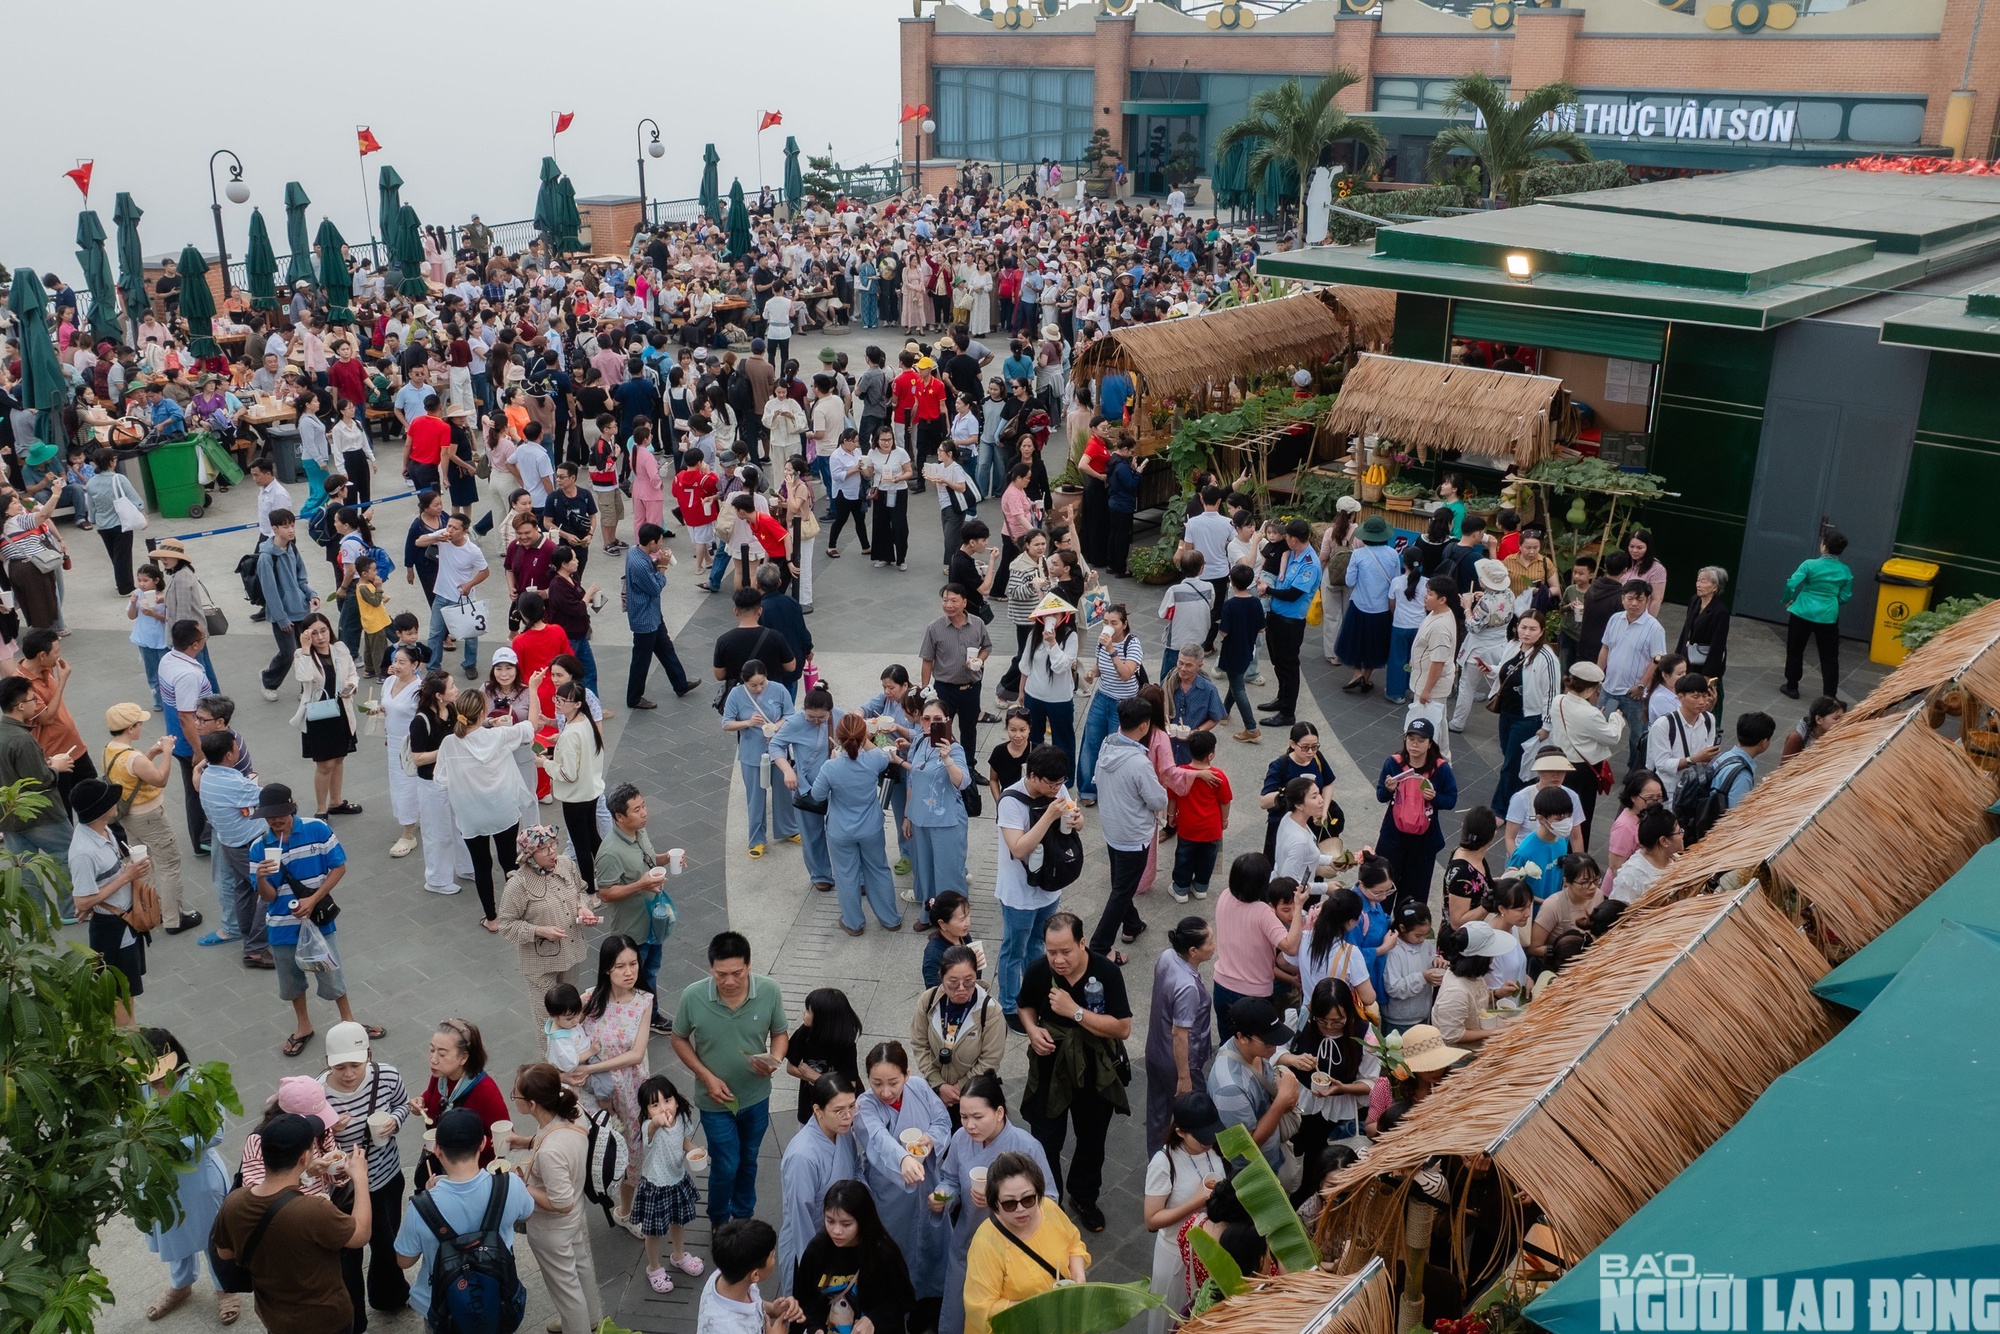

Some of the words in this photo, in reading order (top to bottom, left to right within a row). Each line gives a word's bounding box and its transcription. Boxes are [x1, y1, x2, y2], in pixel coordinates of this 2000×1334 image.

[1584, 101, 1657, 142] THỰC
[1664, 99, 1724, 139] VÂN
[1727, 105, 1795, 142] SƠN
[684, 489, 694, 508] 7
[475, 614, 486, 631] 3
